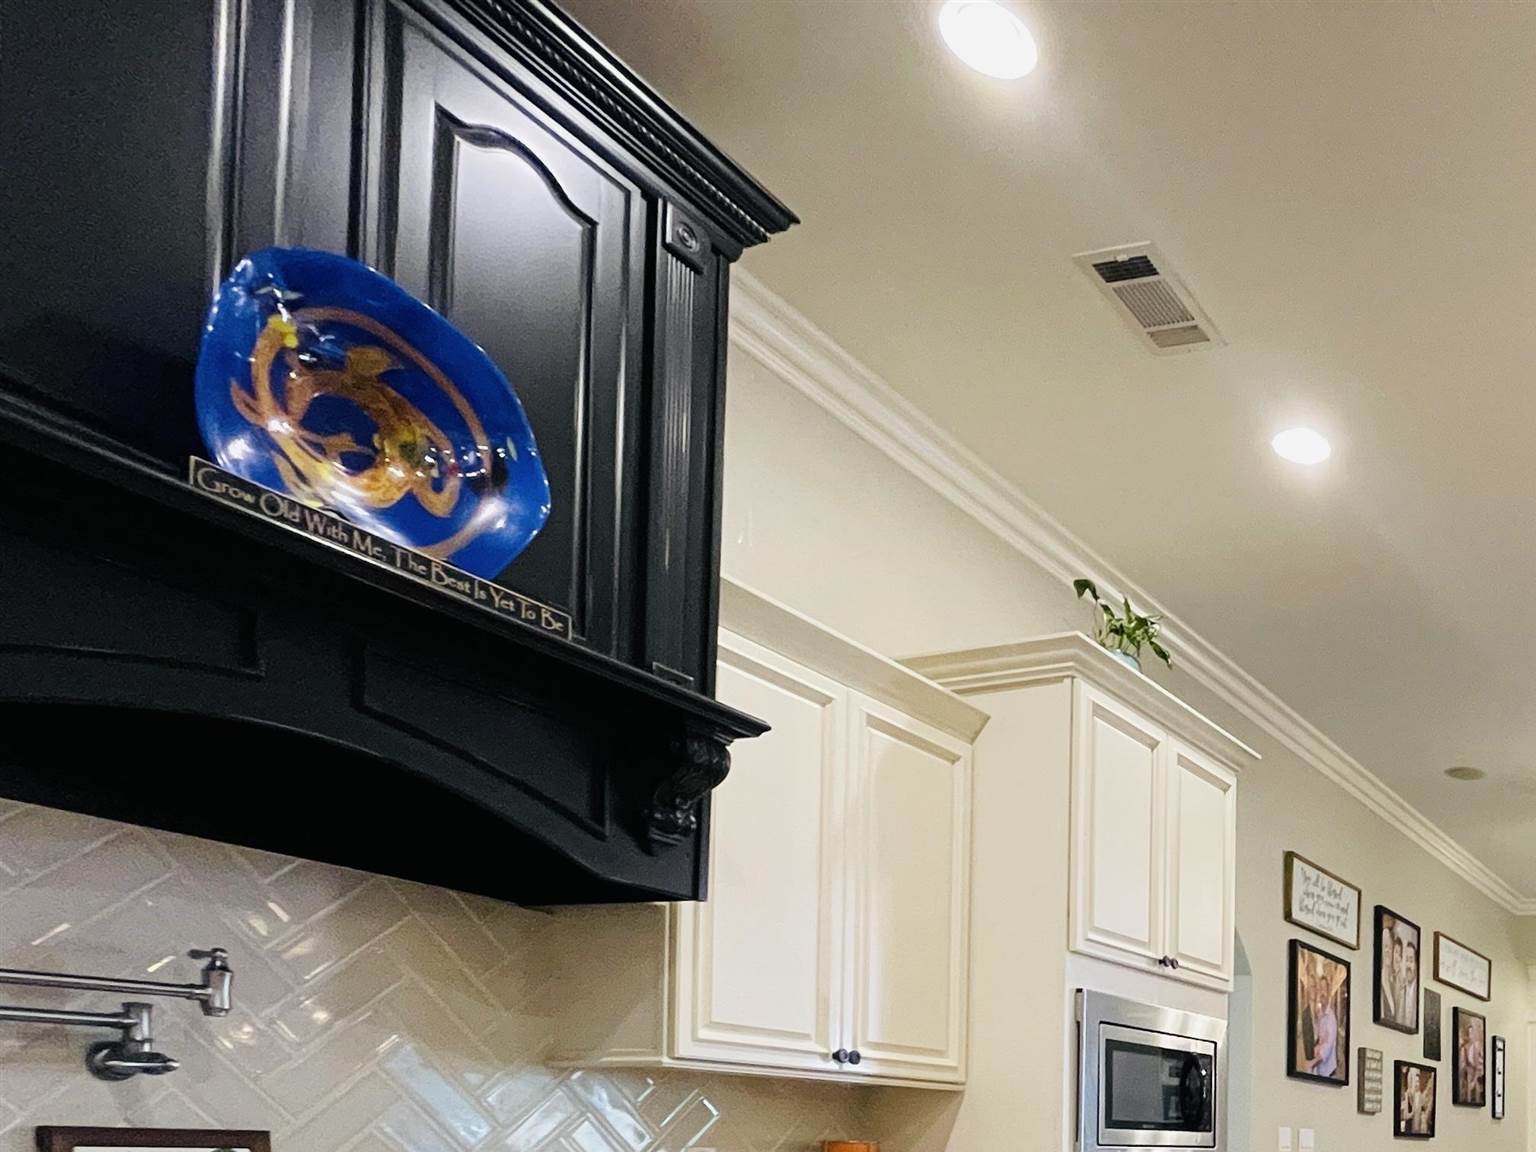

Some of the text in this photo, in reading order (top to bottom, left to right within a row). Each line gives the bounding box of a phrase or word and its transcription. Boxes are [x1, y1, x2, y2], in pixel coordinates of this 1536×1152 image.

[197, 467, 256, 503] Grow
[260, 493, 299, 522] Old
[304, 510, 348, 542] With
[390, 545, 428, 573] The
[431, 561, 471, 594] Best
[474, 580, 487, 600] Is
[489, 586, 516, 612] Yet
[517, 598, 536, 620] To
[541, 608, 565, 632] Be
